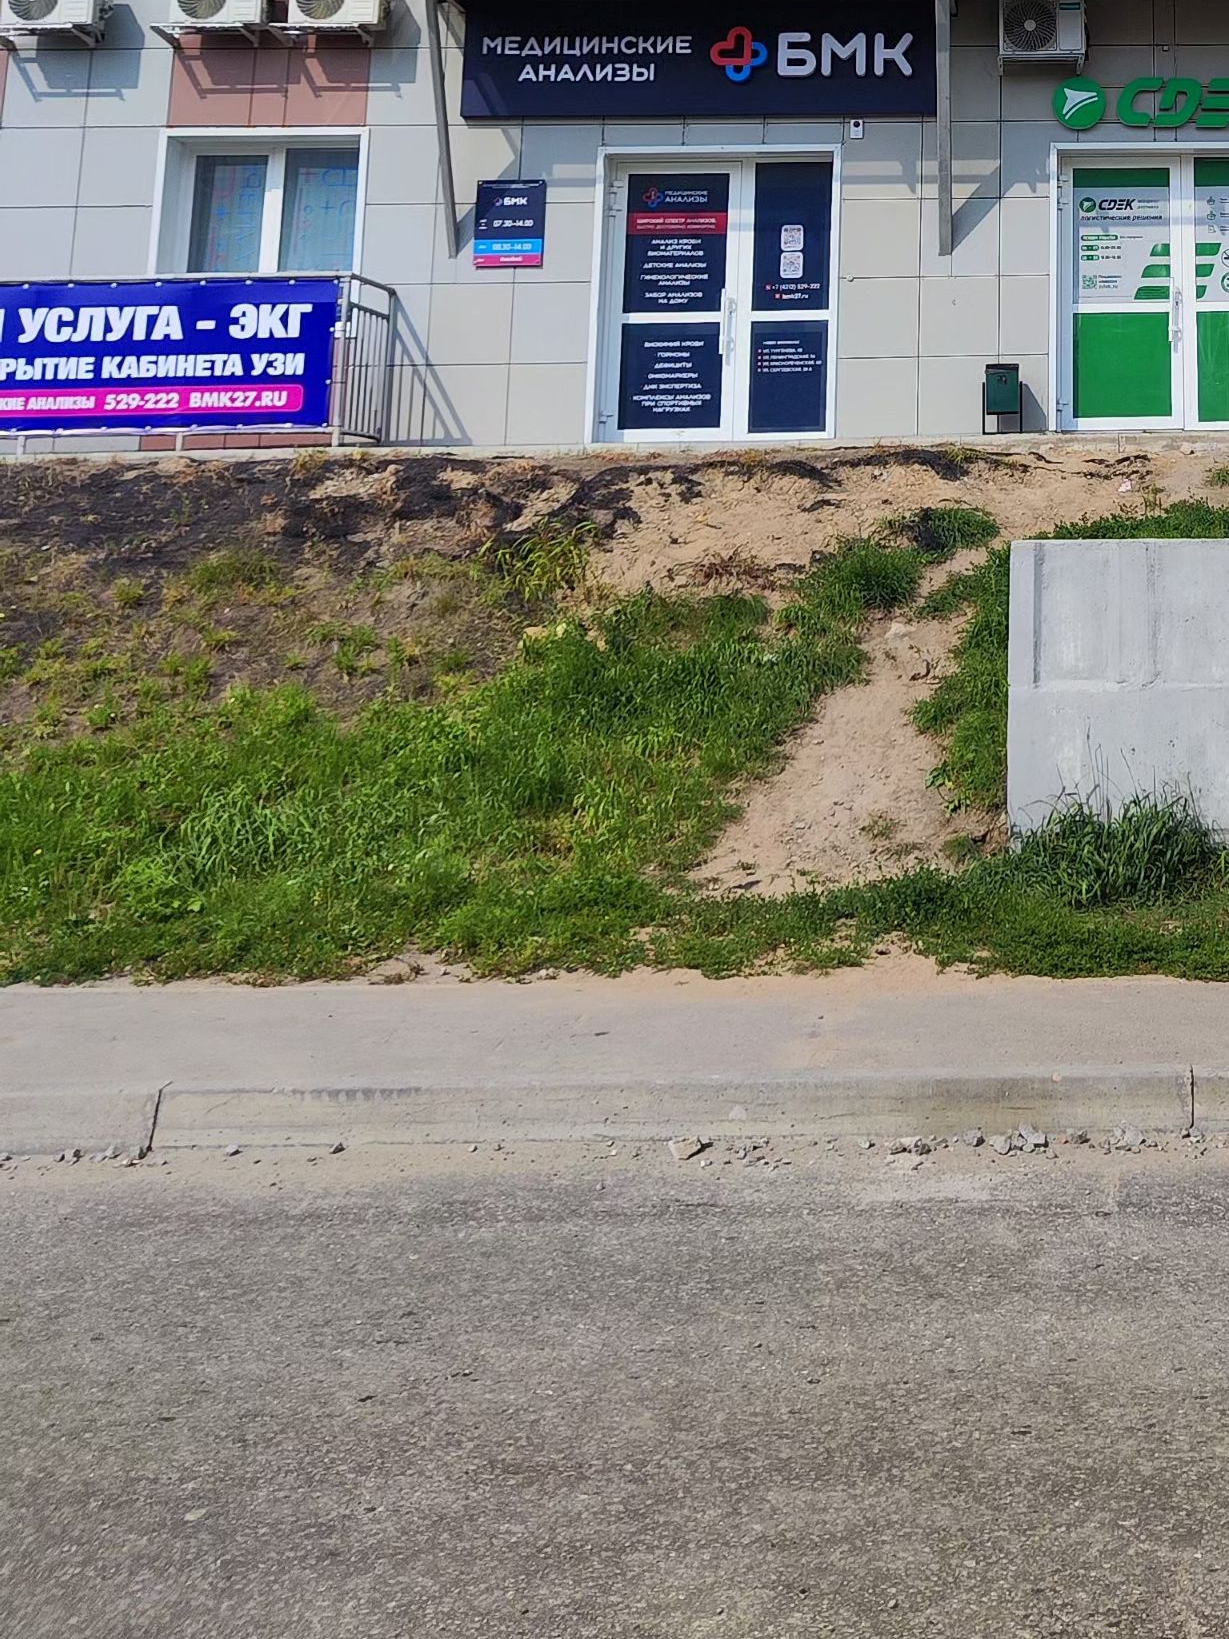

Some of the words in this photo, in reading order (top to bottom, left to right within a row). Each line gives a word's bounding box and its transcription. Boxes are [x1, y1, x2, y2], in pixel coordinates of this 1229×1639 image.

[481, 35, 692, 56] МЕДИЦИНСКИЕ
[776, 32, 914, 78] БМК
[517, 63, 655, 82] АНАЛИЗЫ
[664, 195, 708, 203] АНАЛИЗЫ
[1098, 198, 1135, 211] CDEK
[17, 306, 184, 344] УСЛУГА
[195, 320, 216, 330] -
[228, 303, 313, 340] ЭКГ
[101, 354, 244, 378] КАБИНЕТА
[250, 353, 305, 376] УЗИ
[26, 396, 96, 410] АНАЛИЗЫ
[103, 393, 180, 410] 529-222
[188, 391, 288, 408] BMK27.RU
